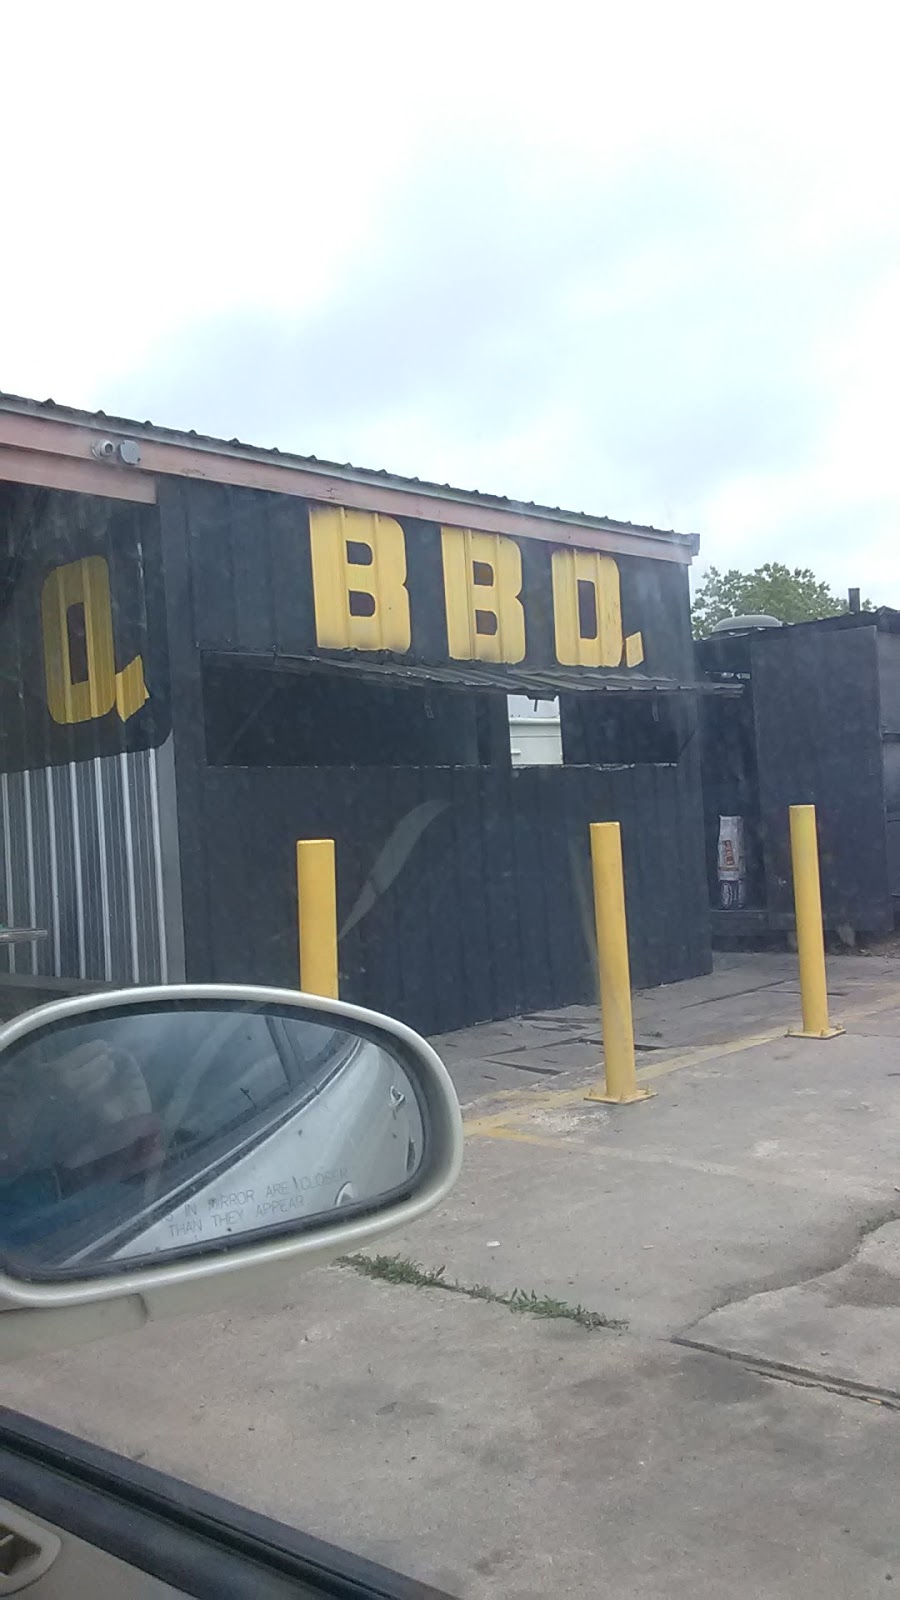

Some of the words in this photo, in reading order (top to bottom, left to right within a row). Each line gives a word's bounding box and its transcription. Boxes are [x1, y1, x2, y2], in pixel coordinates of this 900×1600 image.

[168, 1219, 203, 1238] THAN
[212, 1210, 244, 1228] THEY
[256, 1194, 305, 1218] APPEAR
[184, 1202, 198, 1217] IN
[208, 1189, 255, 1213] MIRROR
[266, 1182, 289, 1198] ARE
